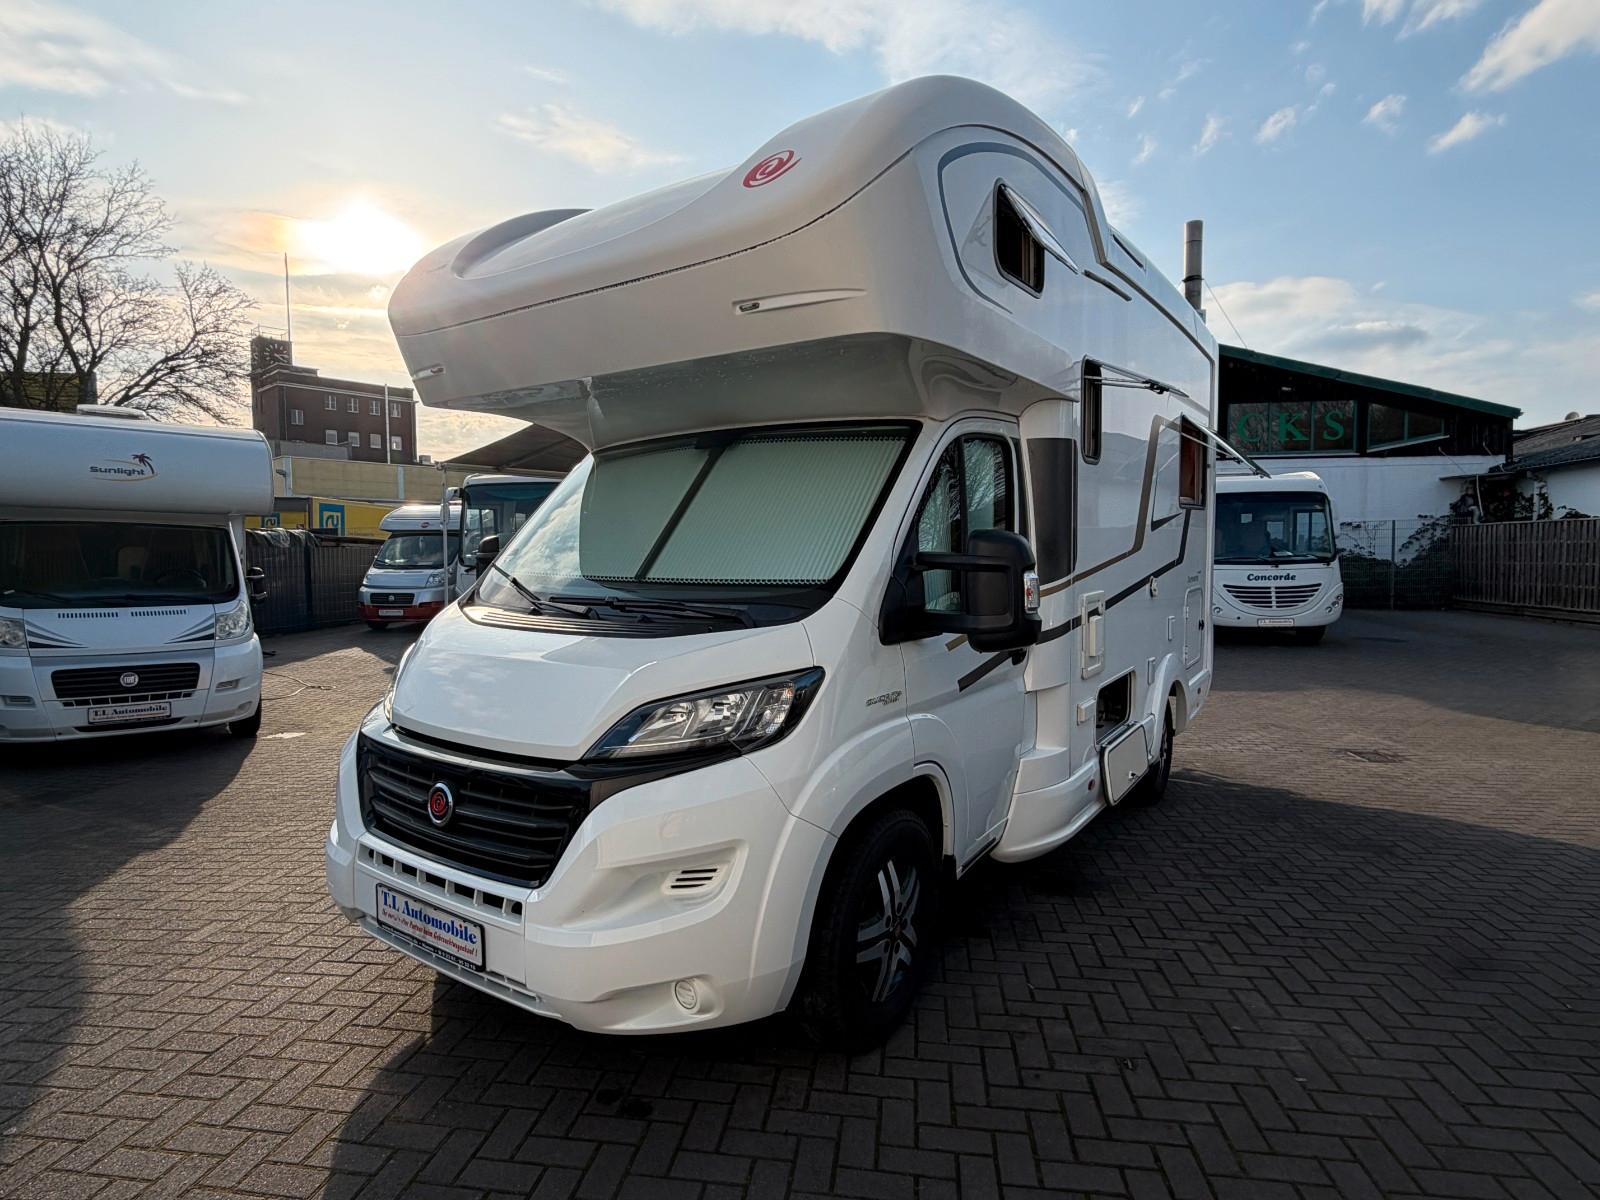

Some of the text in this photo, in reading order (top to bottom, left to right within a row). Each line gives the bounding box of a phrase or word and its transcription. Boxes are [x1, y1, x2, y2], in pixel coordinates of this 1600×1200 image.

[89, 466, 145, 476] Sunlight
[1247, 573, 1296, 581] Concorde
[112, 705, 168, 715] Automobile
[402, 900, 477, 944] Automobile
